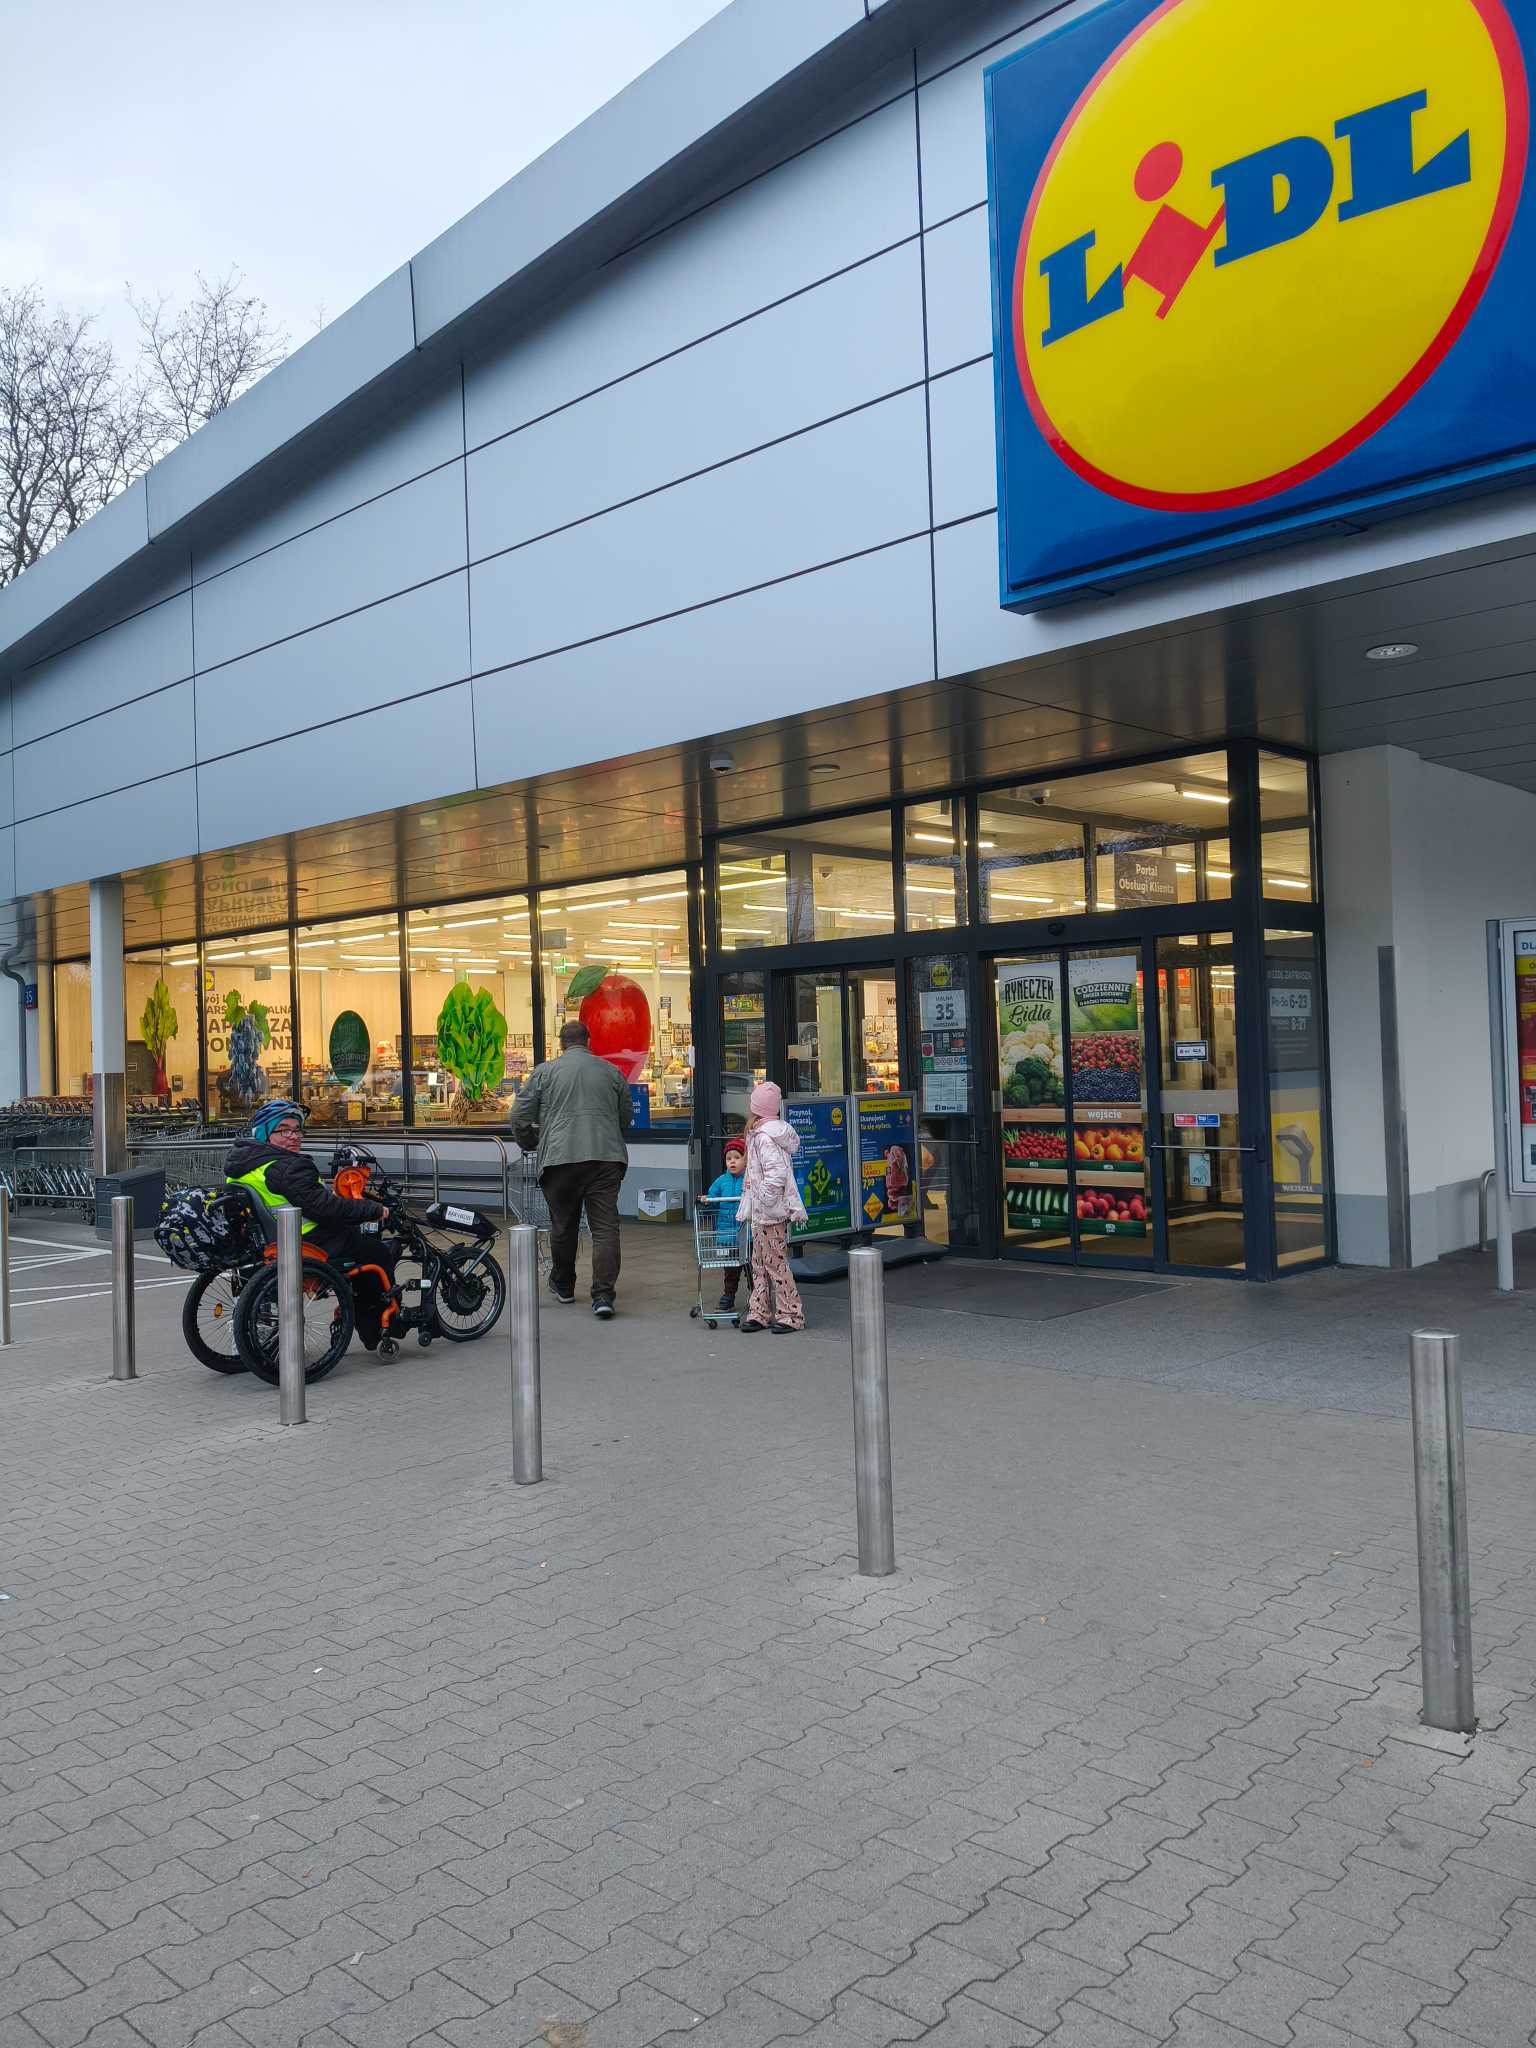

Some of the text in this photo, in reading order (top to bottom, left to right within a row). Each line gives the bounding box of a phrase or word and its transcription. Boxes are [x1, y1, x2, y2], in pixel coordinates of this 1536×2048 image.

[1135, 863, 1158, 877] Portal
[1004, 978, 1055, 1004] RYNECZEK
[1075, 983, 1130, 995] CODZIENNIE
[935, 1003, 955, 1021] 35
[1008, 1004, 1052, 1027] Lidla
